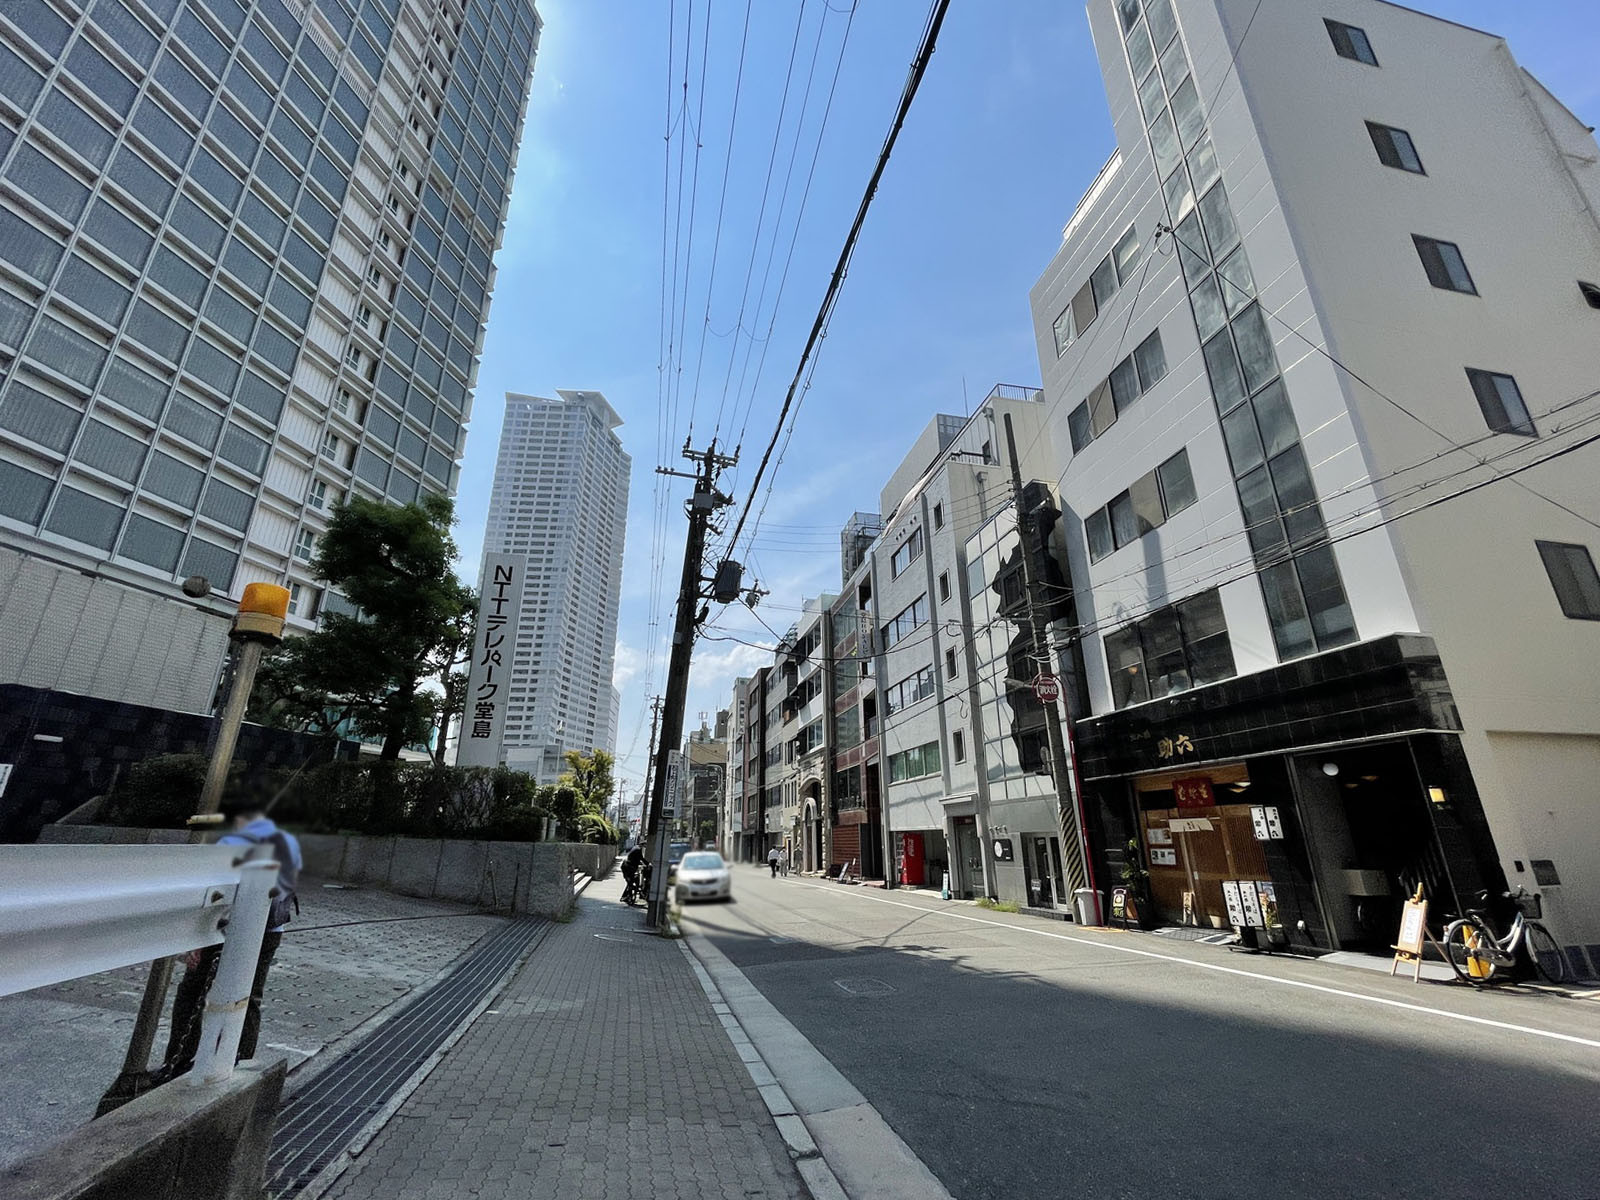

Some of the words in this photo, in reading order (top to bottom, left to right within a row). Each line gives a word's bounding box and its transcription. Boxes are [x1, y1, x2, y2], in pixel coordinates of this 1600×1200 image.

[471, 564, 513, 739] NTTテレパーク堂島
